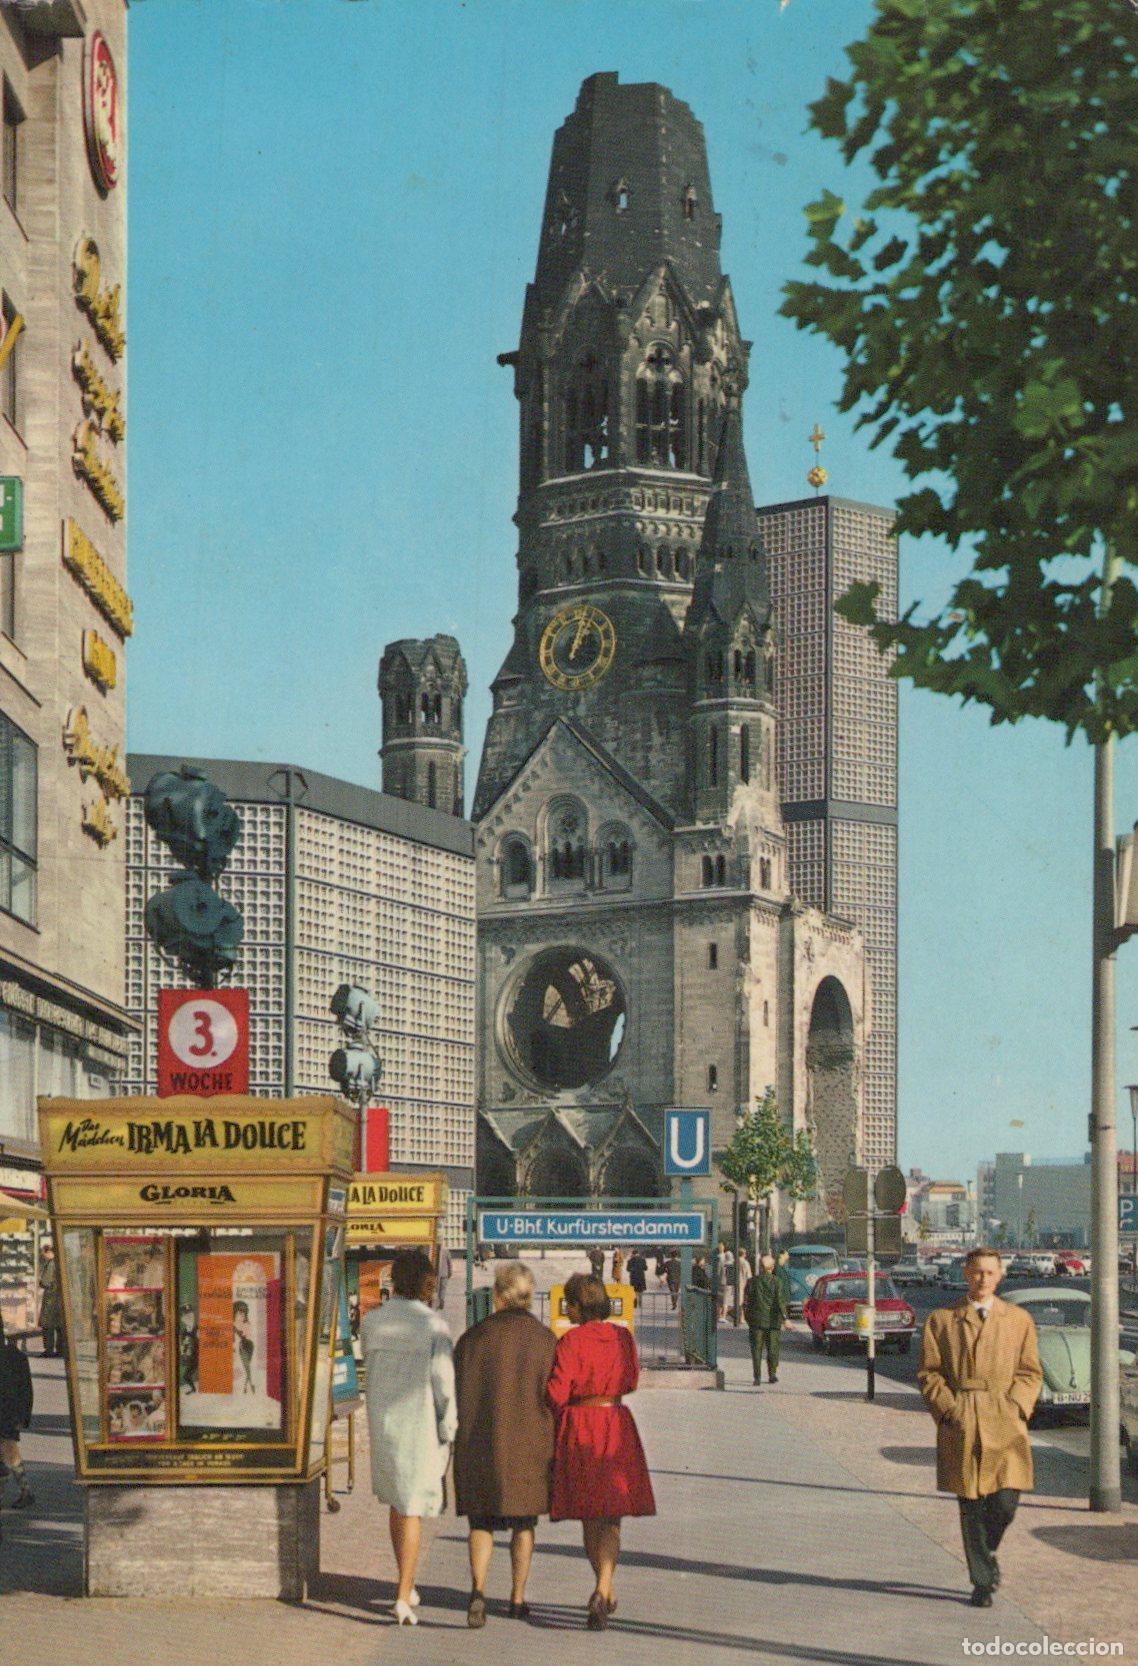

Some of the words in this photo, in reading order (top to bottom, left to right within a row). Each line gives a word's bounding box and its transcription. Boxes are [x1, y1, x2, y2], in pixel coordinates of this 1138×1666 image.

[189, 1011, 218, 1056] 3.
[171, 1072, 233, 1090] WOCHE
[80, 1118, 100, 1132] Das
[127, 1121, 193, 1154] IRMA
[193, 1118, 220, 1149] LA
[222, 1120, 307, 1151] DOUCE
[670, 1117, 704, 1168] U
[139, 1184, 237, 1202] GLORIA
[362, 1185, 377, 1205] LA
[379, 1186, 425, 1203] DOUCE
[1120, 1199, 1134, 1218] P
[496, 1218, 542, 1235] U-Bhf.
[546, 1218, 689, 1236] Kurfürstendamm
